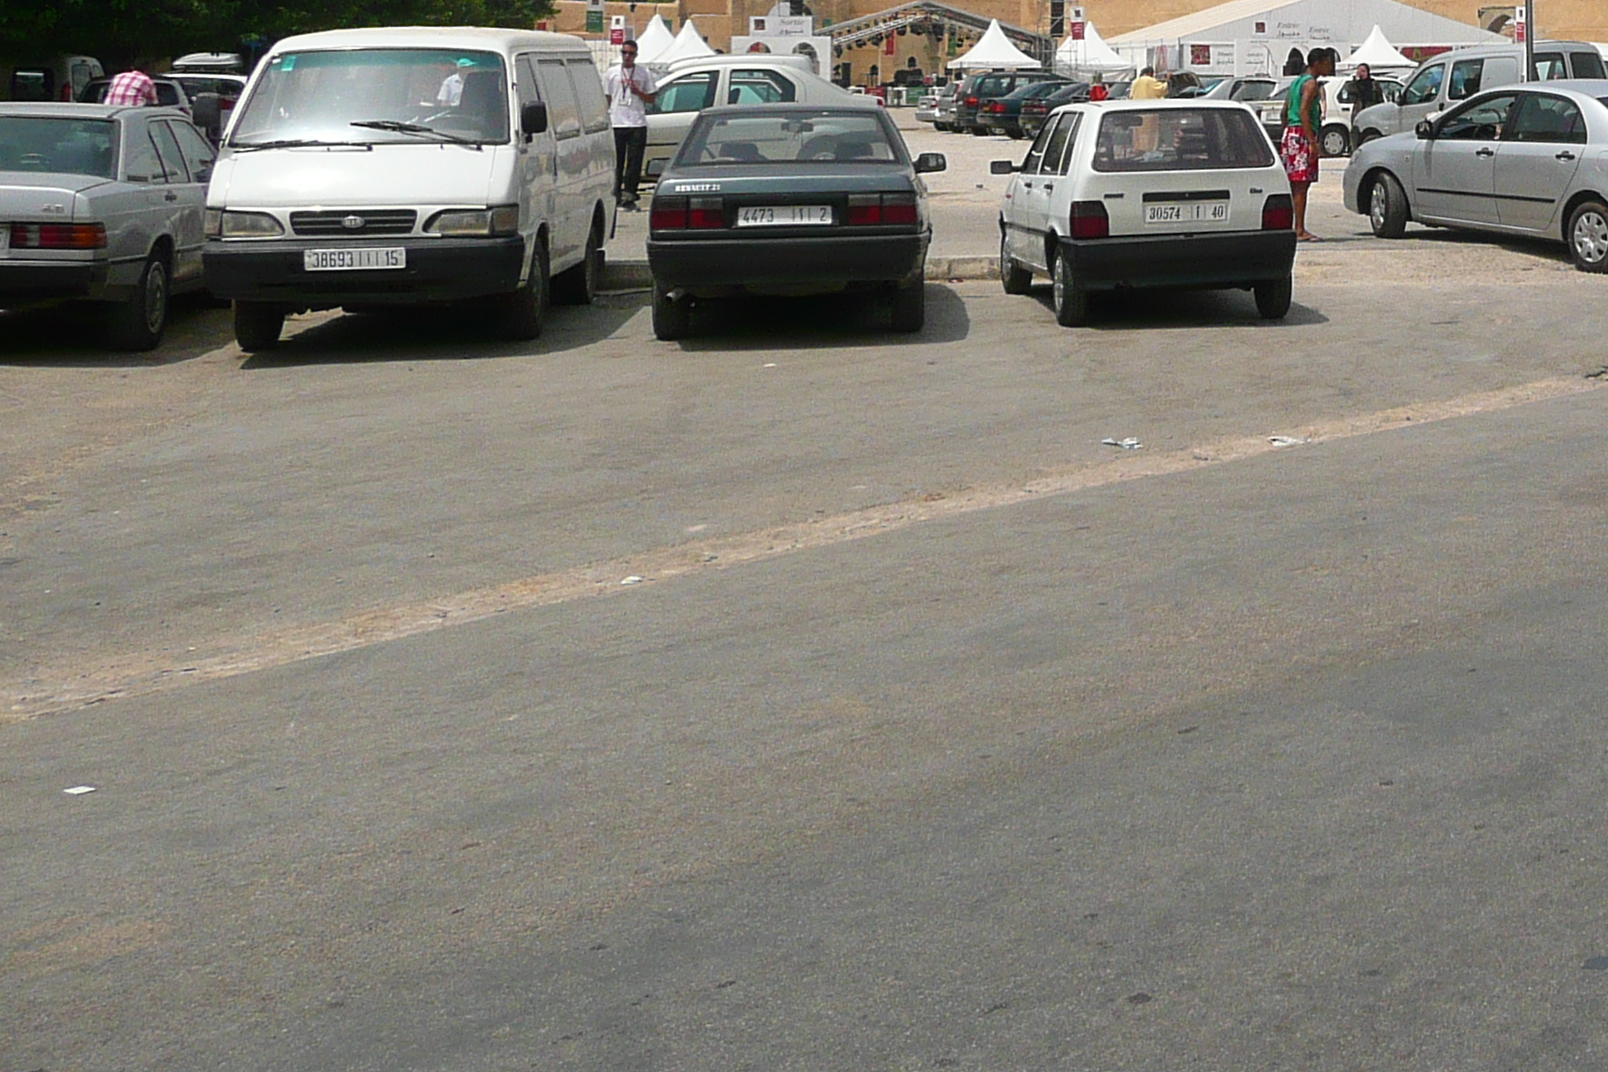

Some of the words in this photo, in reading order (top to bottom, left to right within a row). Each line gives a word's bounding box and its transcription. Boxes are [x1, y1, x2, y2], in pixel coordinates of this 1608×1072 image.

[743, 209, 774, 223] 4473
[1149, 206, 1180, 220] 30574
[1211, 205, 1224, 218] 40
[312, 251, 353, 268] 38693
[385, 250, 398, 266] 15
